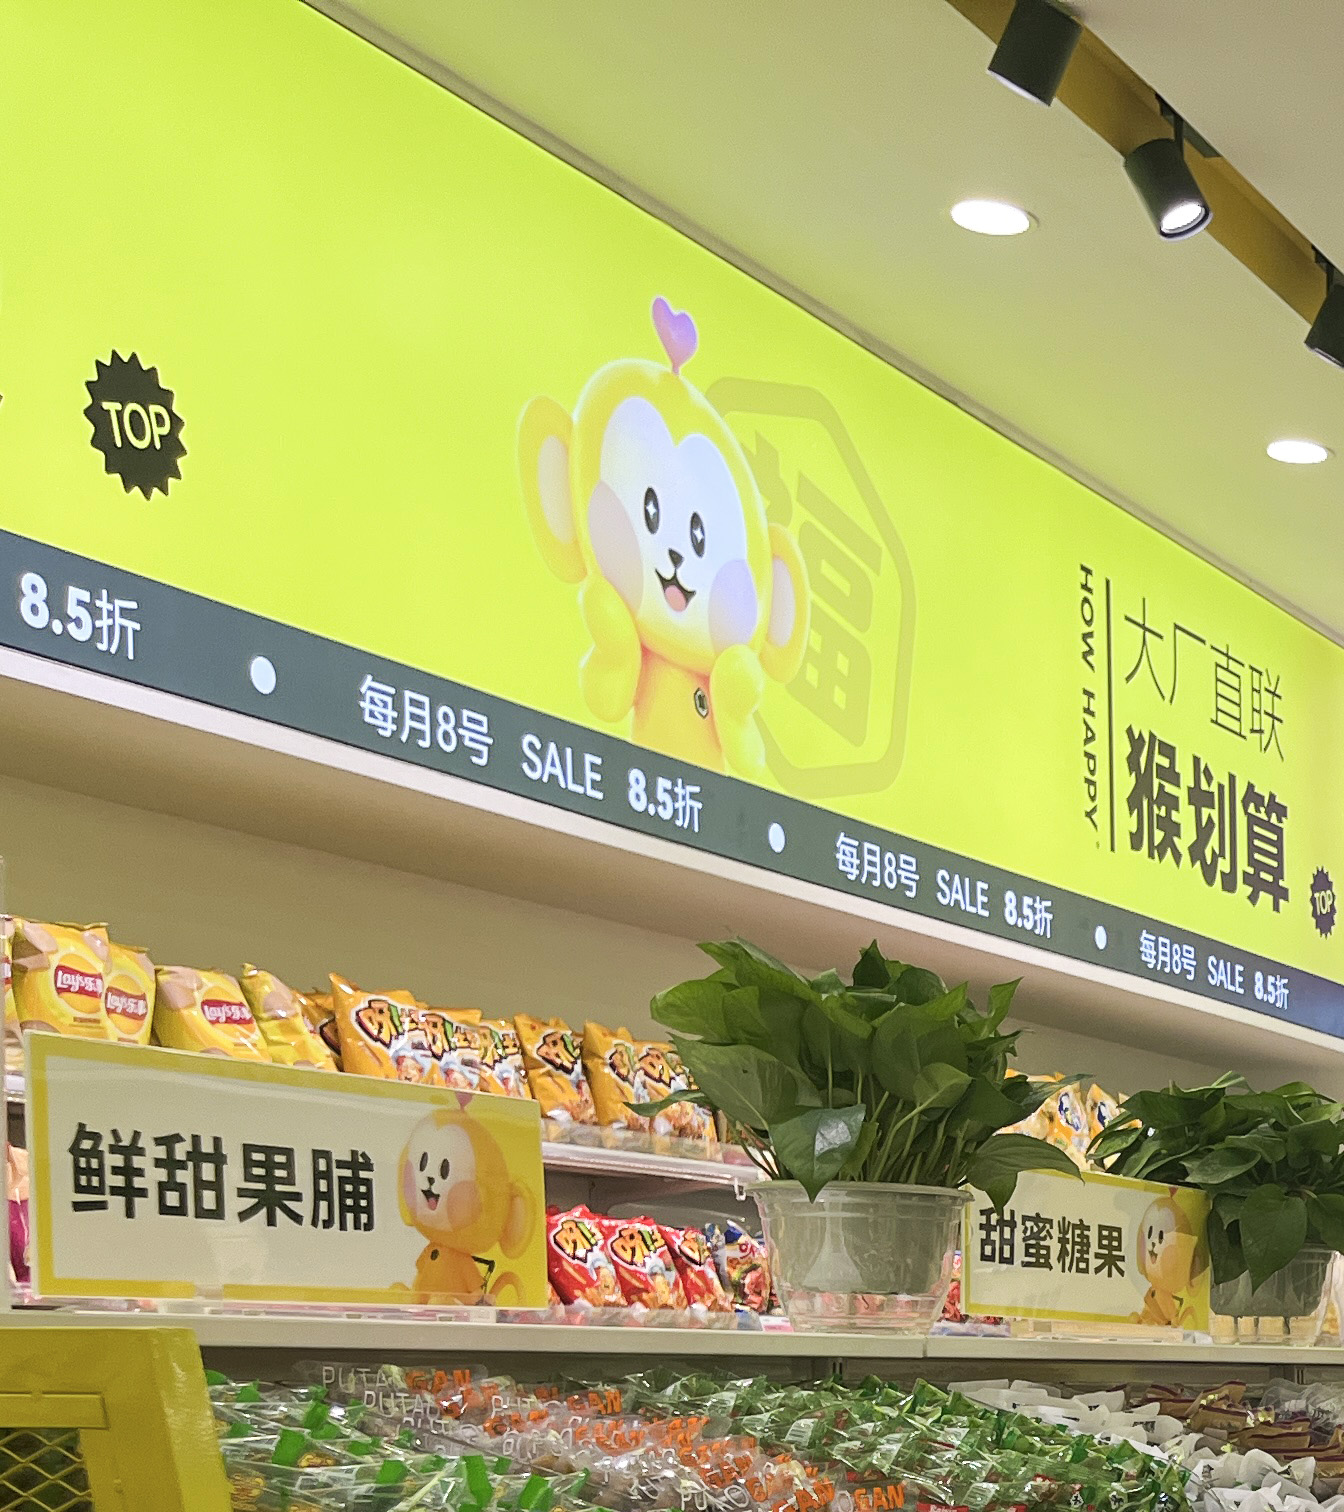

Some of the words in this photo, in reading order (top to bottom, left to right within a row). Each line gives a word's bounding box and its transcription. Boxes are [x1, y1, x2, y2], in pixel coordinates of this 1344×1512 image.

[101, 399, 171, 451] TOP
[20, 571, 141, 661] 8.5折
[1079, 563, 1096, 673] HOW
[1124, 596, 1286, 763] 大厂直联
[358, 673, 493, 768] 每月8号
[521, 733, 605, 801] SALE
[627, 767, 703, 833] 8.5折
[1081, 688, 1099, 832] HAPPY
[1126, 724, 1291, 912] 猴划算
[835, 831, 920, 900] 每月8号
[936, 869, 990, 918] SALE
[1004, 889, 1054, 939] 8.5折
[1313, 889, 1335, 918] TOP
[1139, 928, 1197, 982] 每月8号
[1207, 954, 1245, 995] SALE
[1253, 970, 1290, 1010] 8.5折
[68, 1121, 376, 1234] 鲜甜果脯
[977, 1207, 1127, 1281] 甜蜜糖果
